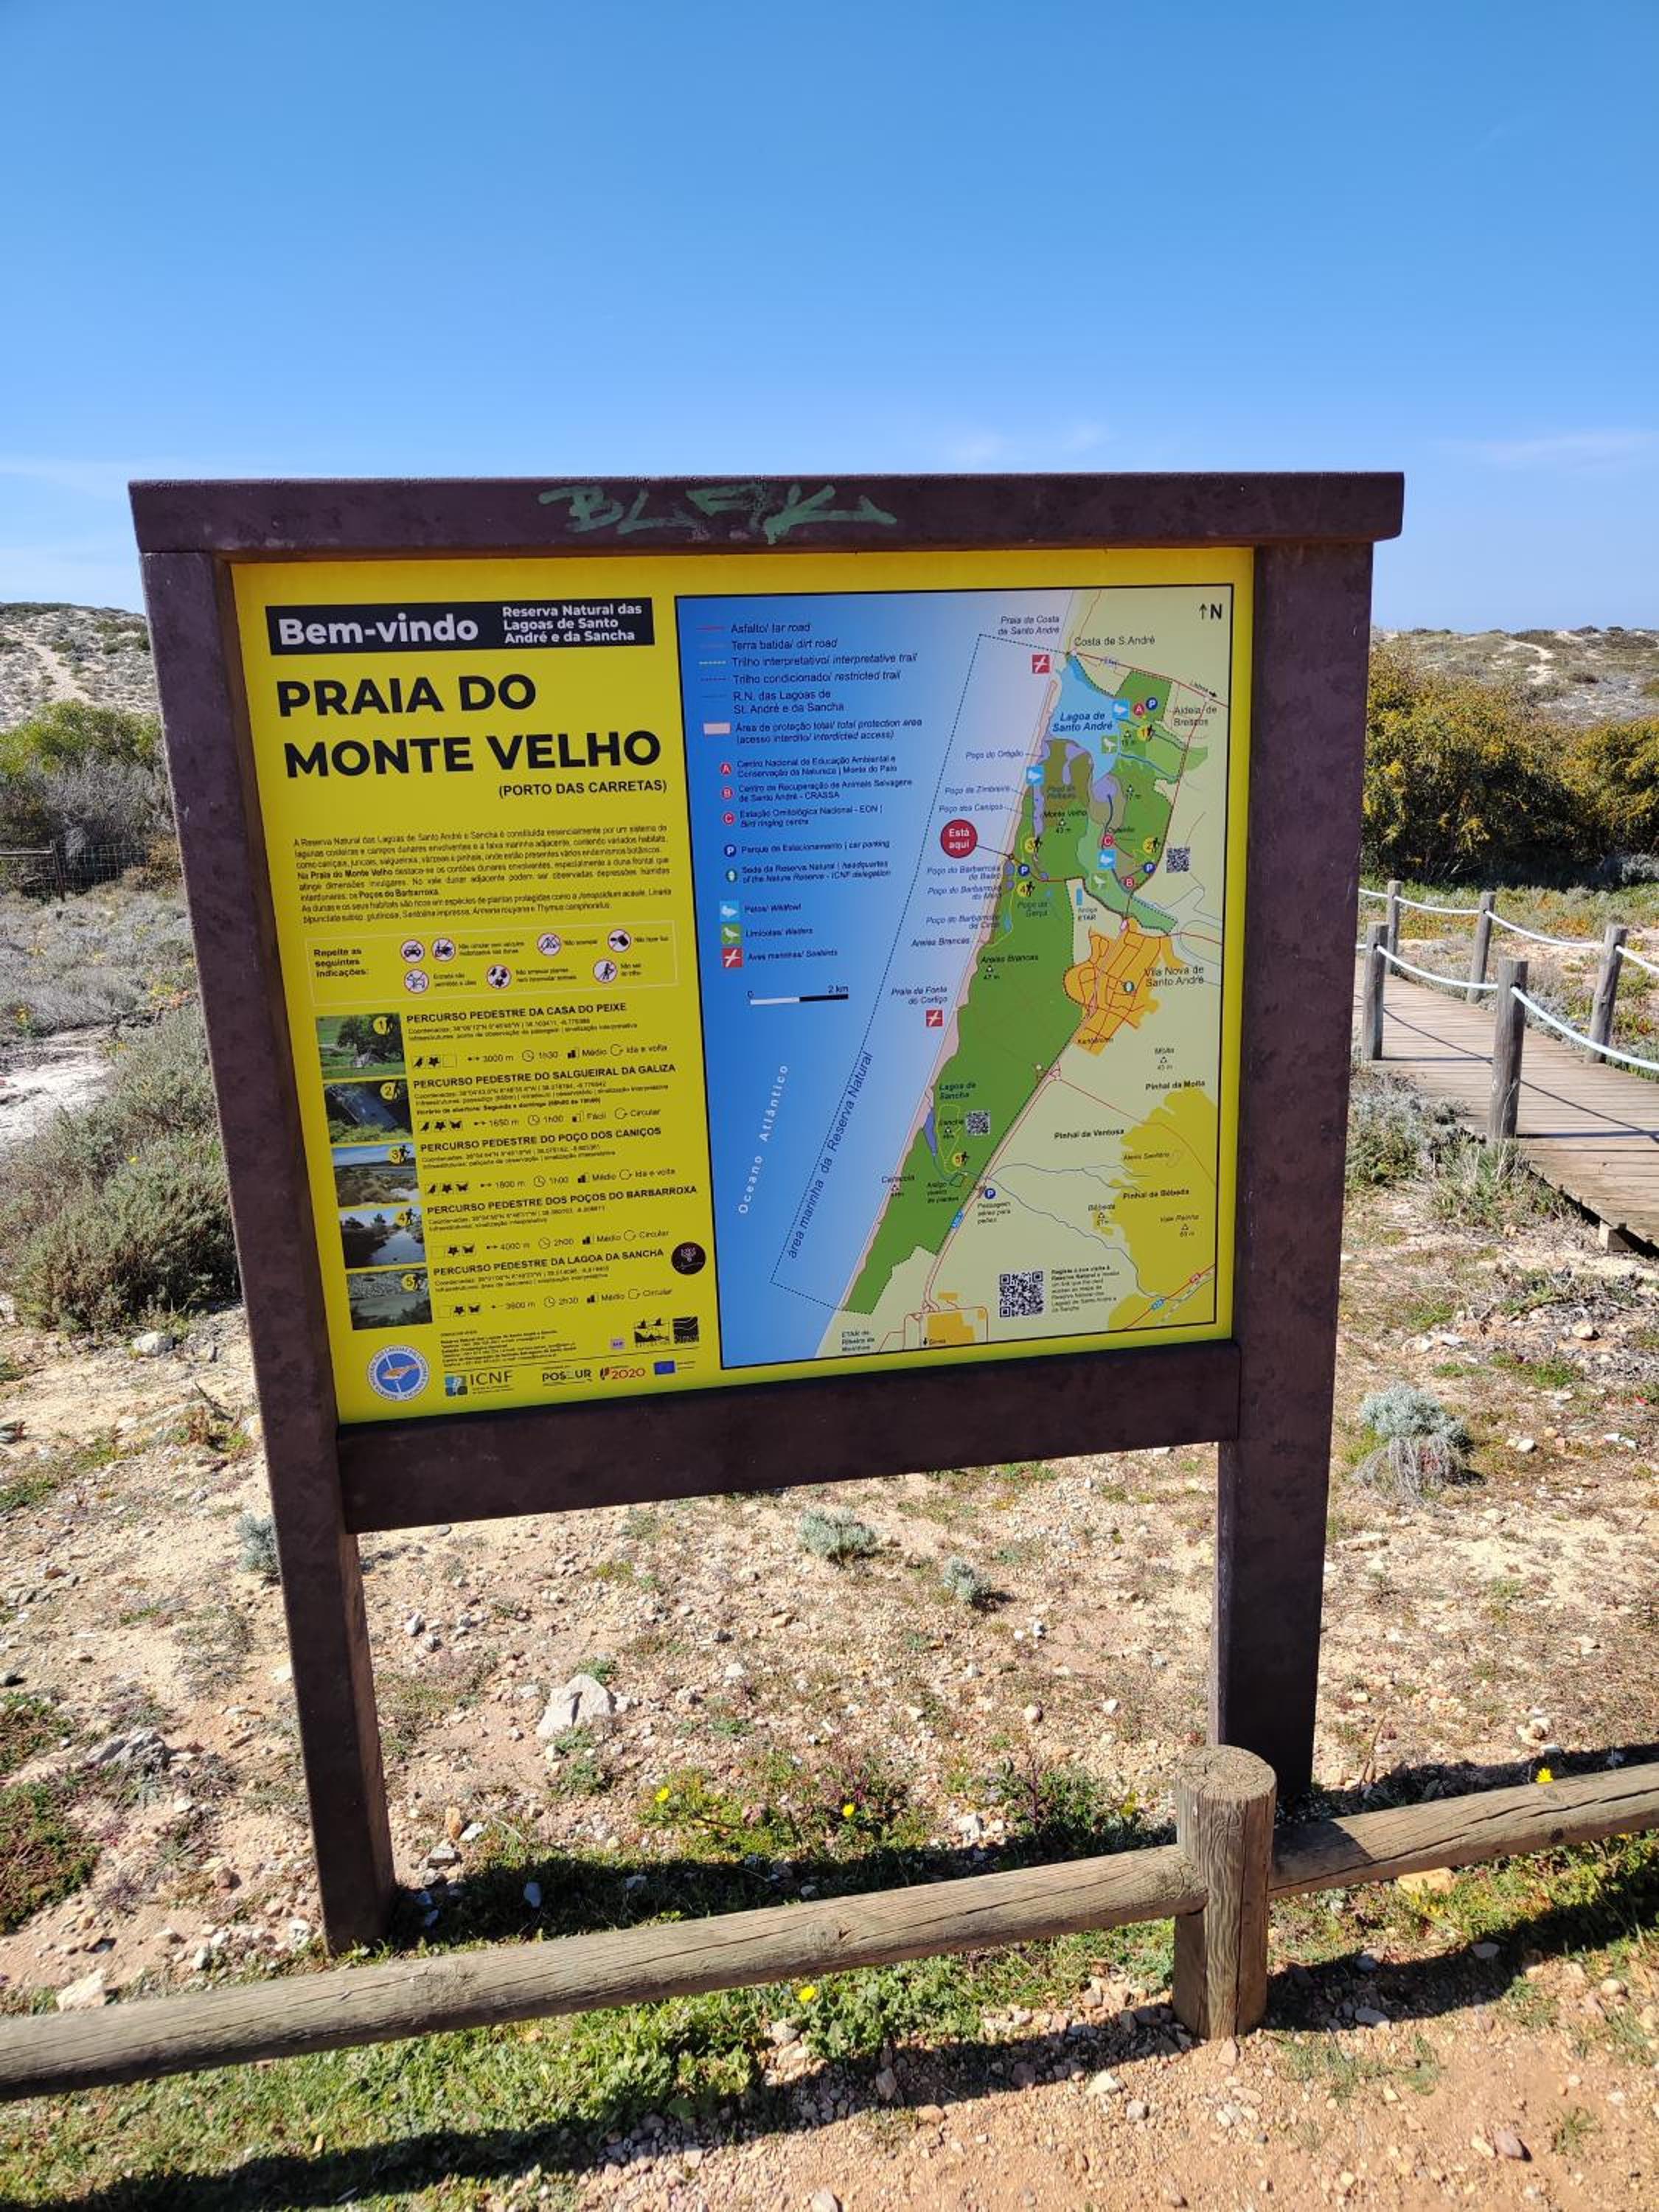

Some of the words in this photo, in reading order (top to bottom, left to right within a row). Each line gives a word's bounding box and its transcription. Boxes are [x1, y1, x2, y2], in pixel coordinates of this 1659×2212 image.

[502, 606, 558, 617] Reserva
[563, 604, 613, 616] Natural
[617, 604, 643, 615] das
[1210, 603, 1222, 619] N
[278, 612, 479, 646] Bem-vindo
[504, 619, 554, 633] Lagoas
[557, 618, 574, 629] de
[578, 617, 619, 628] Santo
[787, 622, 811, 633] road
[504, 631, 548, 644] André
[551, 633, 560, 642] e
[563, 630, 581, 642] da
[584, 629, 636, 641] Sancha
[1074, 636, 1101, 647] Costa
[1104, 636, 1116, 645] de
[731, 640, 757, 650] Terra
[796, 639, 812, 649] dirt
[815, 638, 838, 648] road
[731, 656, 759, 667] Trilho
[732, 674, 760, 684] Trilho
[834, 671, 880, 681] restricted
[276, 676, 444, 717] PRAIA
[459, 673, 536, 712] DO
[759, 690, 776, 700] das
[779, 691, 815, 701] Lagoas
[818, 689, 831, 699] de
[750, 703, 779, 714] André
[807, 701, 844, 712] Sancha
[1060, 712, 1093, 723] Lagoa
[1094, 712, 1105, 720] de
[1052, 723, 1082, 732] Santo
[1083, 721, 1113, 731] André
[284, 737, 474, 779] MONTE
[485, 730, 661, 770] VELHO
[498, 783, 552, 799] (PORTO
[556, 782, 585, 794] DAS
[588, 779, 668, 793] CARRETAS)
[949, 828, 970, 838] Está
[949, 840, 970, 850] aqui
[315, 959, 360, 968] seguintes
[1144, 967, 1161, 977] Vila
[1164, 966, 1189, 976] Nova
[1192, 965, 1204, 974] de
[1145, 978, 1173, 987] Santo
[1175, 975, 1204, 986] André
[828, 985, 834, 993] 2
[835, 984, 849, 993] km
[406, 1013, 467, 1023] PERCURSO
[470, 1008, 526, 1020] PEDESTRE
[529, 1007, 544, 1016] DA
[546, 1006, 576, 1015] CASA
[578, 1005, 594, 1014] DO
[596, 1003, 626, 1012] PEIXE
[414, 1077, 473, 1088] PERCURSO
[476, 1073, 532, 1085] PEDESTRE
[535, 1072, 550, 1081] DO
[552, 1068, 618, 1079] SALGUEIRAL
[621, 1067, 636, 1075] DA
[638, 1064, 676, 1074] GALIZA
[630, 1108, 661, 1117] Circular
[420, 1141, 480, 1152] PERCURSO
[482, 1136, 537, 1148] PEDESTRE
[540, 1135, 555, 1144] DO
[558, 1133, 588, 1143] POÇO
[591, 1130, 613, 1140] DOS
[616, 1127, 661, 1139] CANIÇOS
[799, 1179, 825, 1230] marinha
[821, 1157, 832, 1174] da
[827, 1100, 855, 1152] Reserva
[848, 1051, 874, 1099] Natural
[1054, 1131, 1079, 1140] Pinhal
[1093, 1128, 1124, 1137] Ventosa
[738, 1155, 764, 1214] Oceano
[427, 1203, 485, 1214] PERCURSO
[488, 1198, 543, 1210] PEDESTRE
[546, 1196, 567, 1206] DOS
[570, 1193, 607, 1204] POÇOS
[609, 1192, 624, 1200] DO
[626, 1186, 697, 1199] BARBARROXA
[639, 1230, 669, 1239] Circular
[434, 1263, 491, 1276] PERCURSO
[493, 1259, 548, 1270] PEDESTRE
[551, 1258, 566, 1267] DA
[567, 1255, 603, 1265] LAGOA
[605, 1253, 620, 1262] DA
[623, 1248, 664, 1259] SANCHA
[642, 1289, 672, 1298] Circular
[470, 1371, 513, 1385] ICNF
[611, 1367, 646, 1380] 2020
